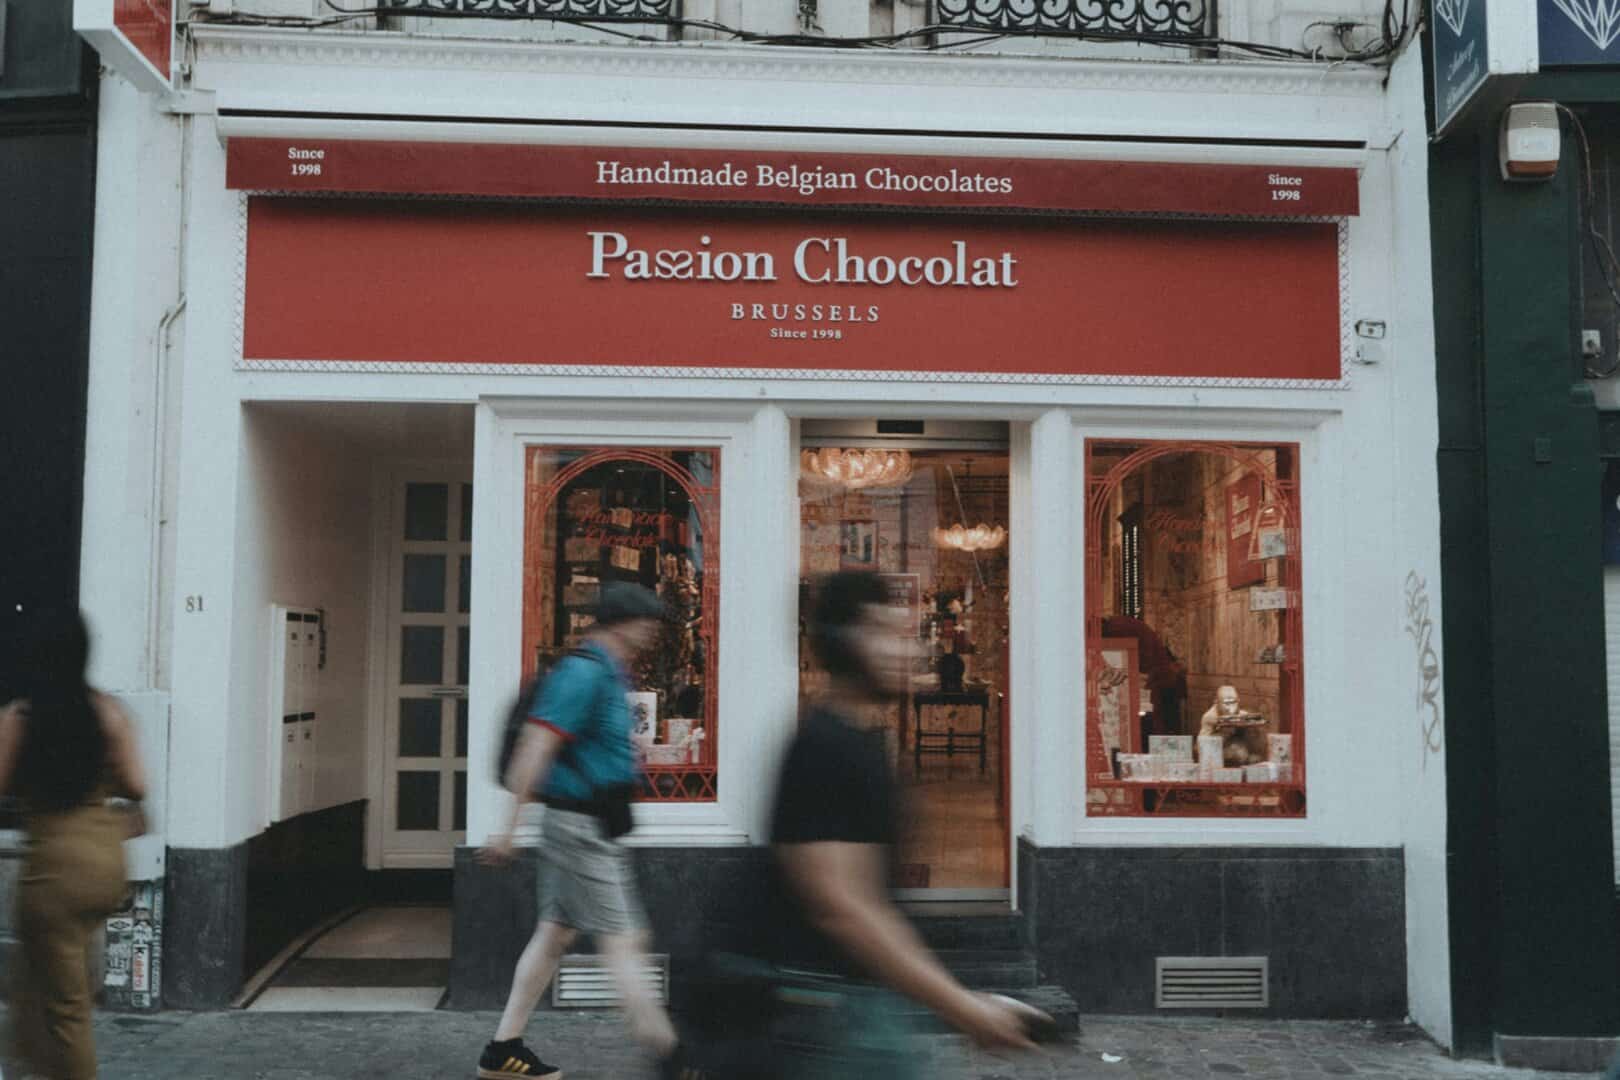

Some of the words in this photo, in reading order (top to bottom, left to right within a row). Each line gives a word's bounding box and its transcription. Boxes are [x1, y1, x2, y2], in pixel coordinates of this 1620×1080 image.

[288, 147, 325, 159] Since
[291, 163, 322, 176] 1998
[596, 161, 748, 186] Handmade
[756, 165, 857, 195] Belgian
[864, 168, 1014, 193] Chocolates
[1268, 173, 1303, 185] Since
[1271, 190, 1301, 201] 1998
[585, 231, 778, 282] Passion
[793, 237, 1019, 287] Chocolat
[731, 303, 880, 322] BRUSSELS
[769, 328, 808, 339] Since
[811, 329, 843, 340] 1998
[184, 595, 204, 613] 81
